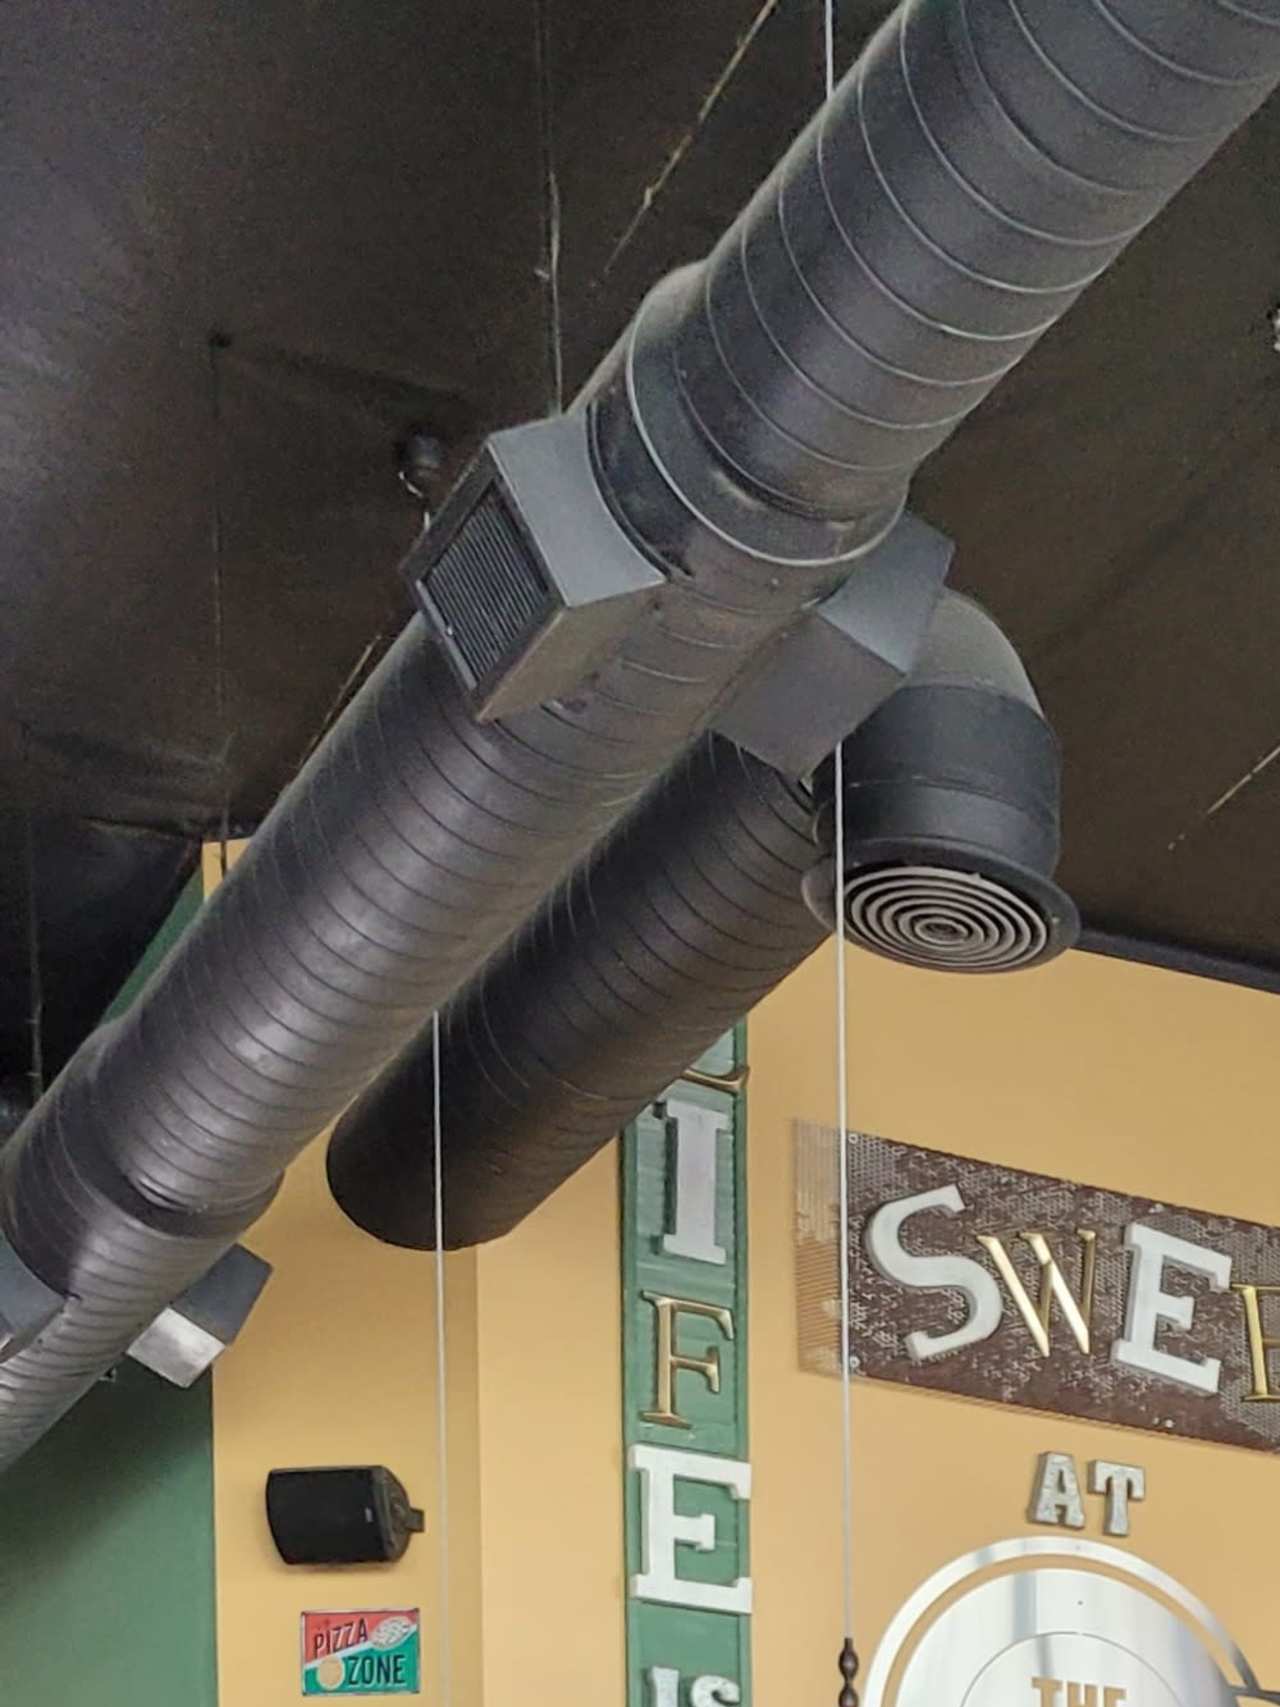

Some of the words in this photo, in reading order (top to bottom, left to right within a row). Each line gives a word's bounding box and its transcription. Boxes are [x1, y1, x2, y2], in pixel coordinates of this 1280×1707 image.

[627, 1065, 753, 1614] IFE
[1026, 1450, 1146, 1536] AT
[314, 1617, 368, 1659] PIZZA
[346, 1653, 405, 1685] ZONE
